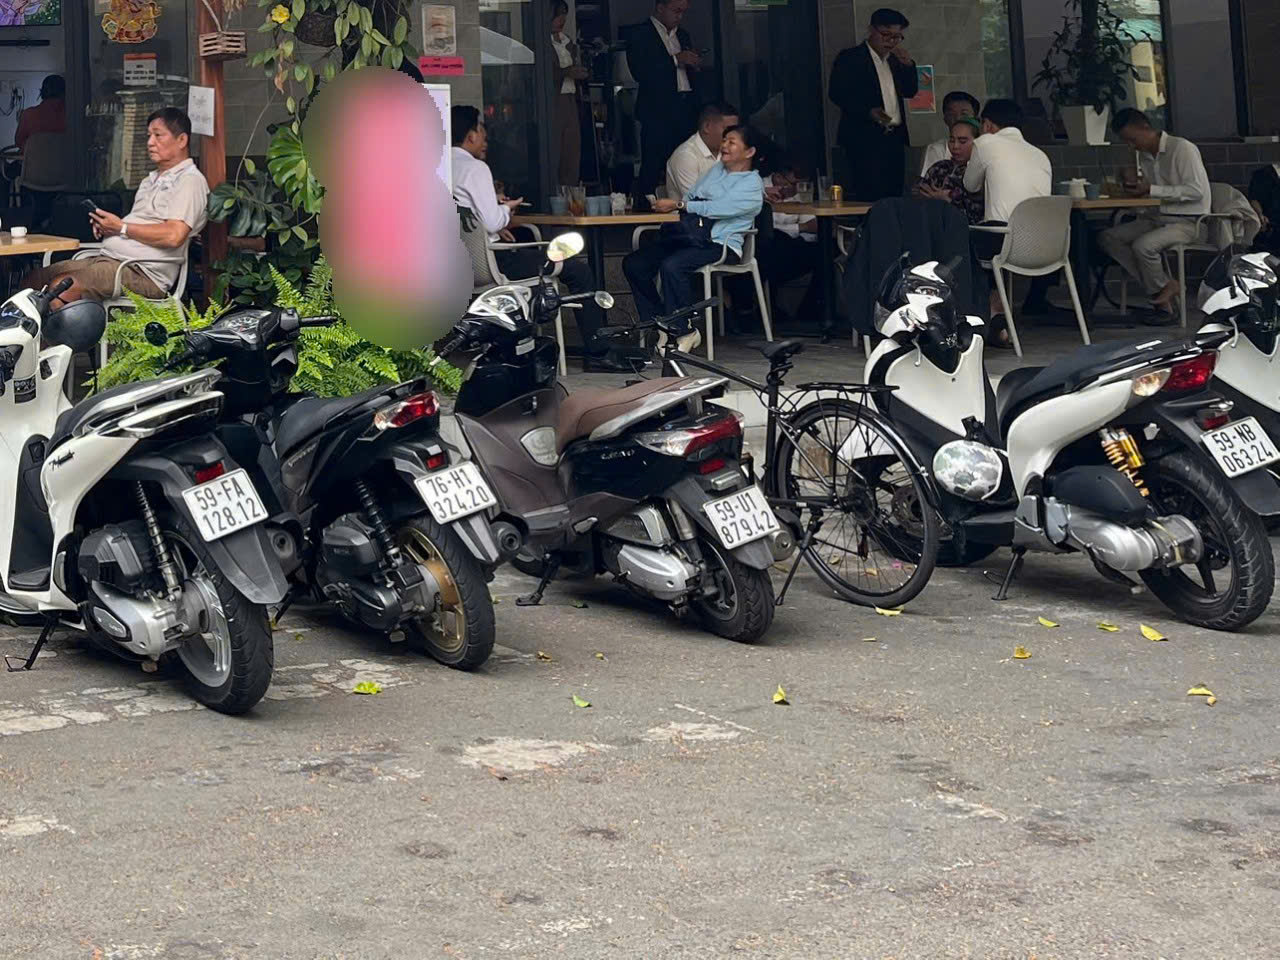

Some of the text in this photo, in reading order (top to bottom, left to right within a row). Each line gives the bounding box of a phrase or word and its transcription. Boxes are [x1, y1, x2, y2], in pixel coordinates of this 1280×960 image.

[1211, 423, 1257, 451] 59-NB
[1222, 441, 1275, 473] 063.24
[193, 477, 245, 511] 59-FA
[425, 468, 472, 496] 76-H1
[203, 497, 261, 535] 128.12
[433, 485, 490, 519] 324.20
[714, 492, 758, 521] 59-U1
[721, 510, 776, 544] 879.42
